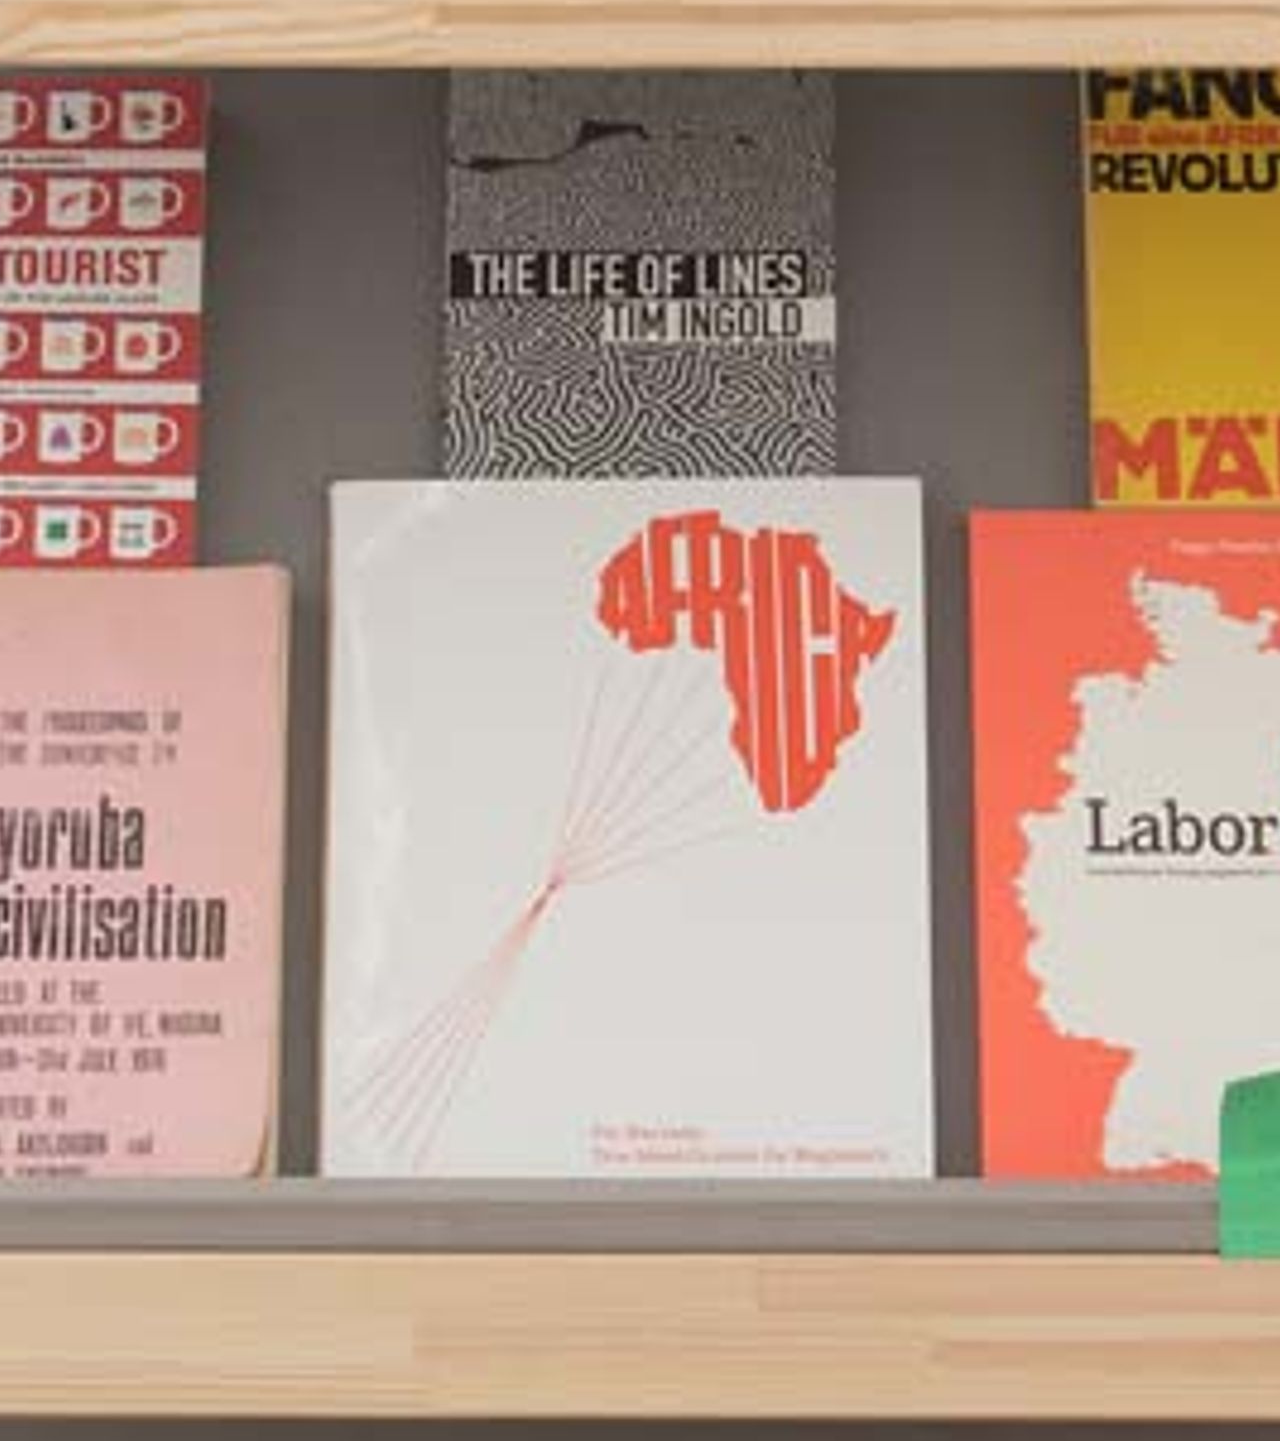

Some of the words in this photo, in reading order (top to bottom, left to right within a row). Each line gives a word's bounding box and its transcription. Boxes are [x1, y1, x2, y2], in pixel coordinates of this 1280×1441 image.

[468, 252, 538, 296] THE
[547, 252, 626, 296] LIFE
[636, 252, 684, 296] OF
[696, 252, 804, 296] LINES
[609, 302, 670, 339] TIM
[681, 302, 804, 339] INGOLD
[1085, 798, 1279, 856] Labor
